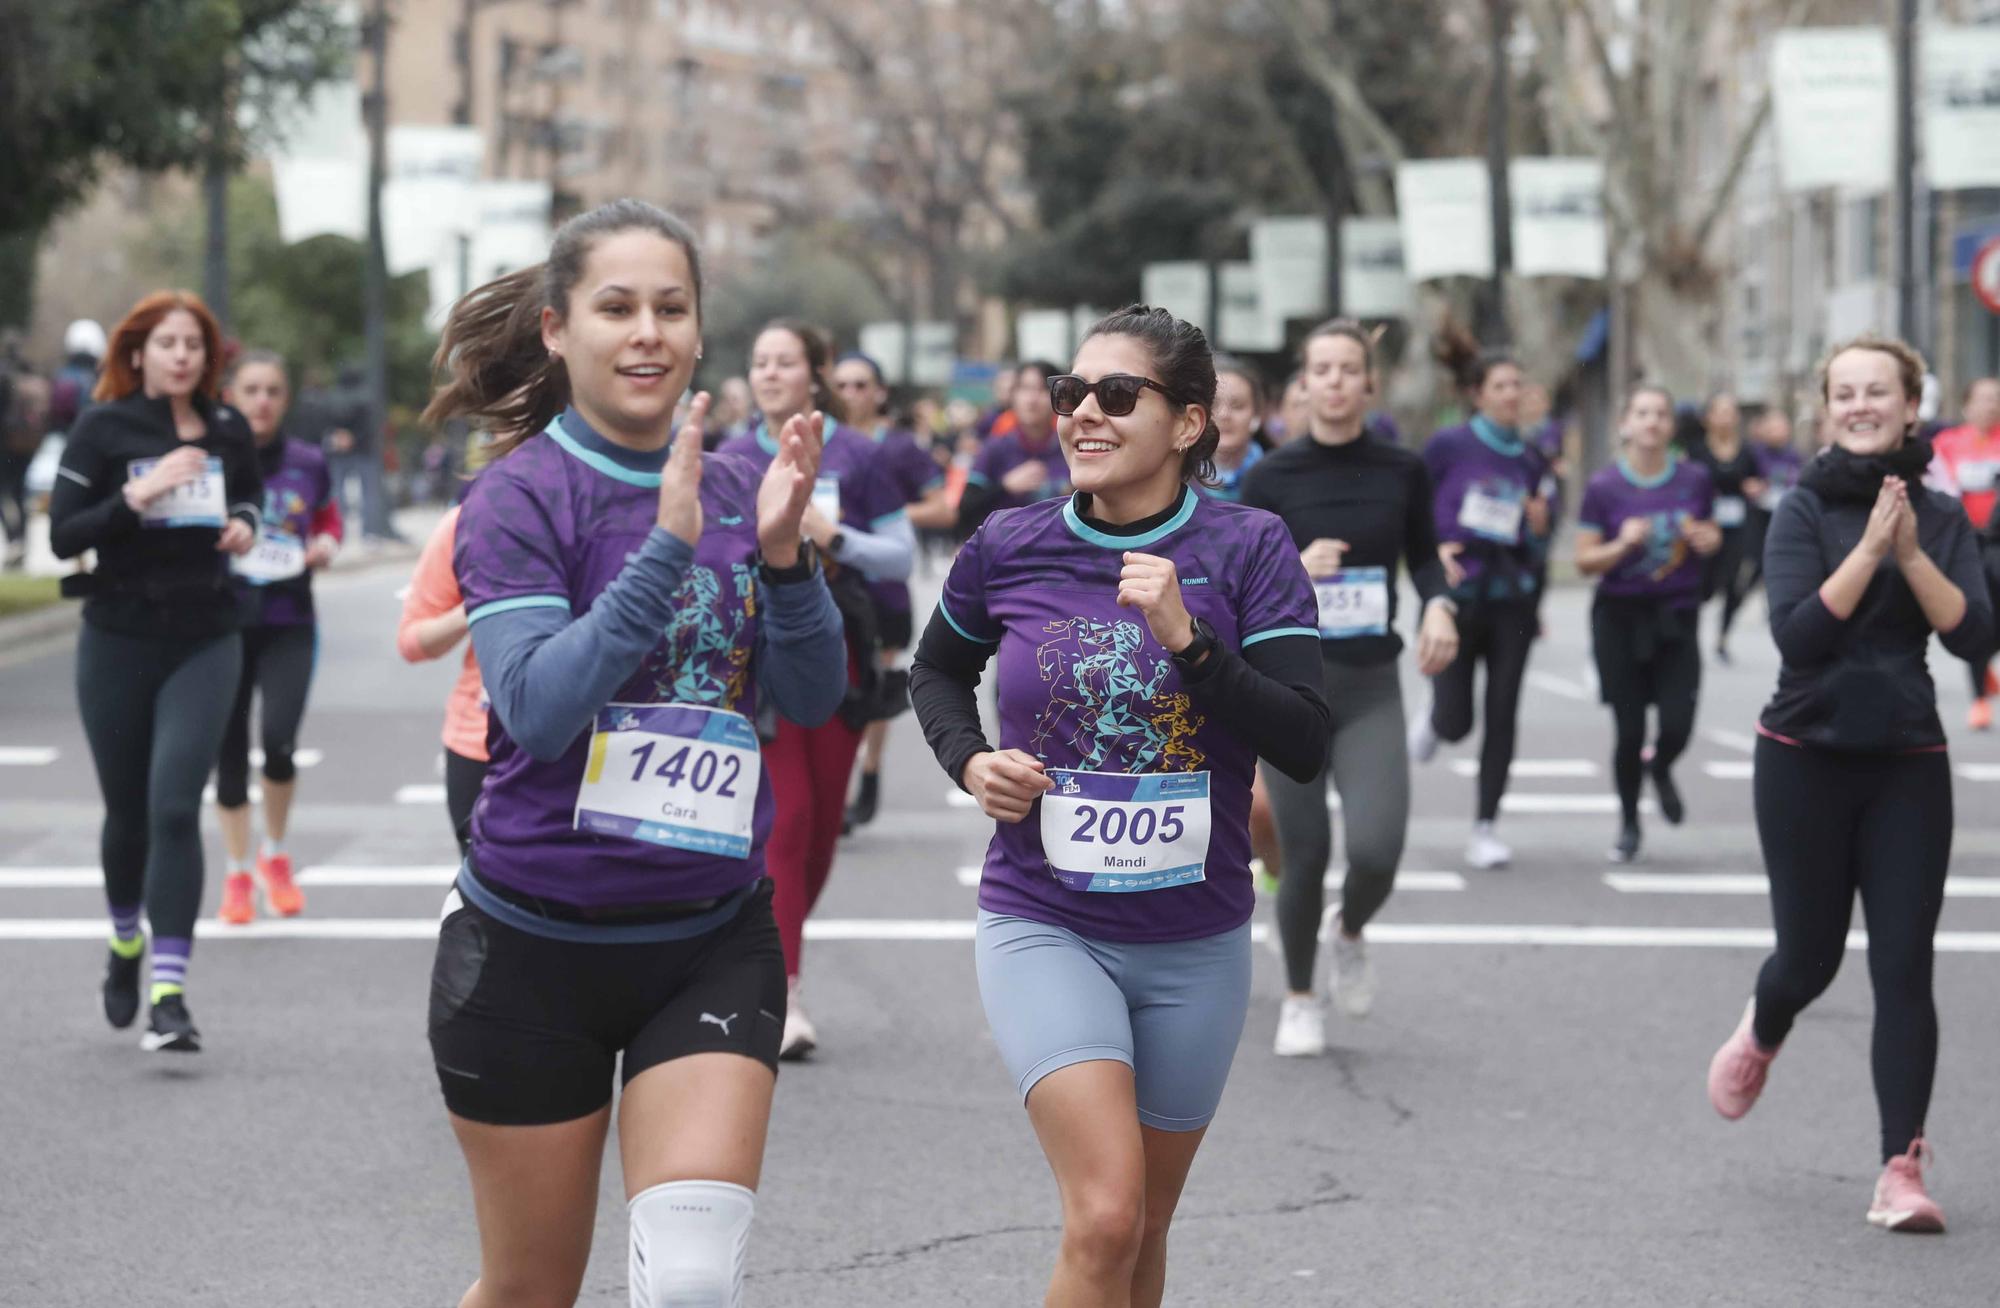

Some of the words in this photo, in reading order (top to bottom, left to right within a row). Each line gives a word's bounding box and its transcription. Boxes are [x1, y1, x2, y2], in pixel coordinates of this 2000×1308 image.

[1181, 577, 1209, 586] RUNNEX
[630, 741, 741, 799] 1402
[661, 802, 698, 821] Cara
[1070, 804, 1185, 846] 2005
[1104, 855, 1147, 868] Mandi
